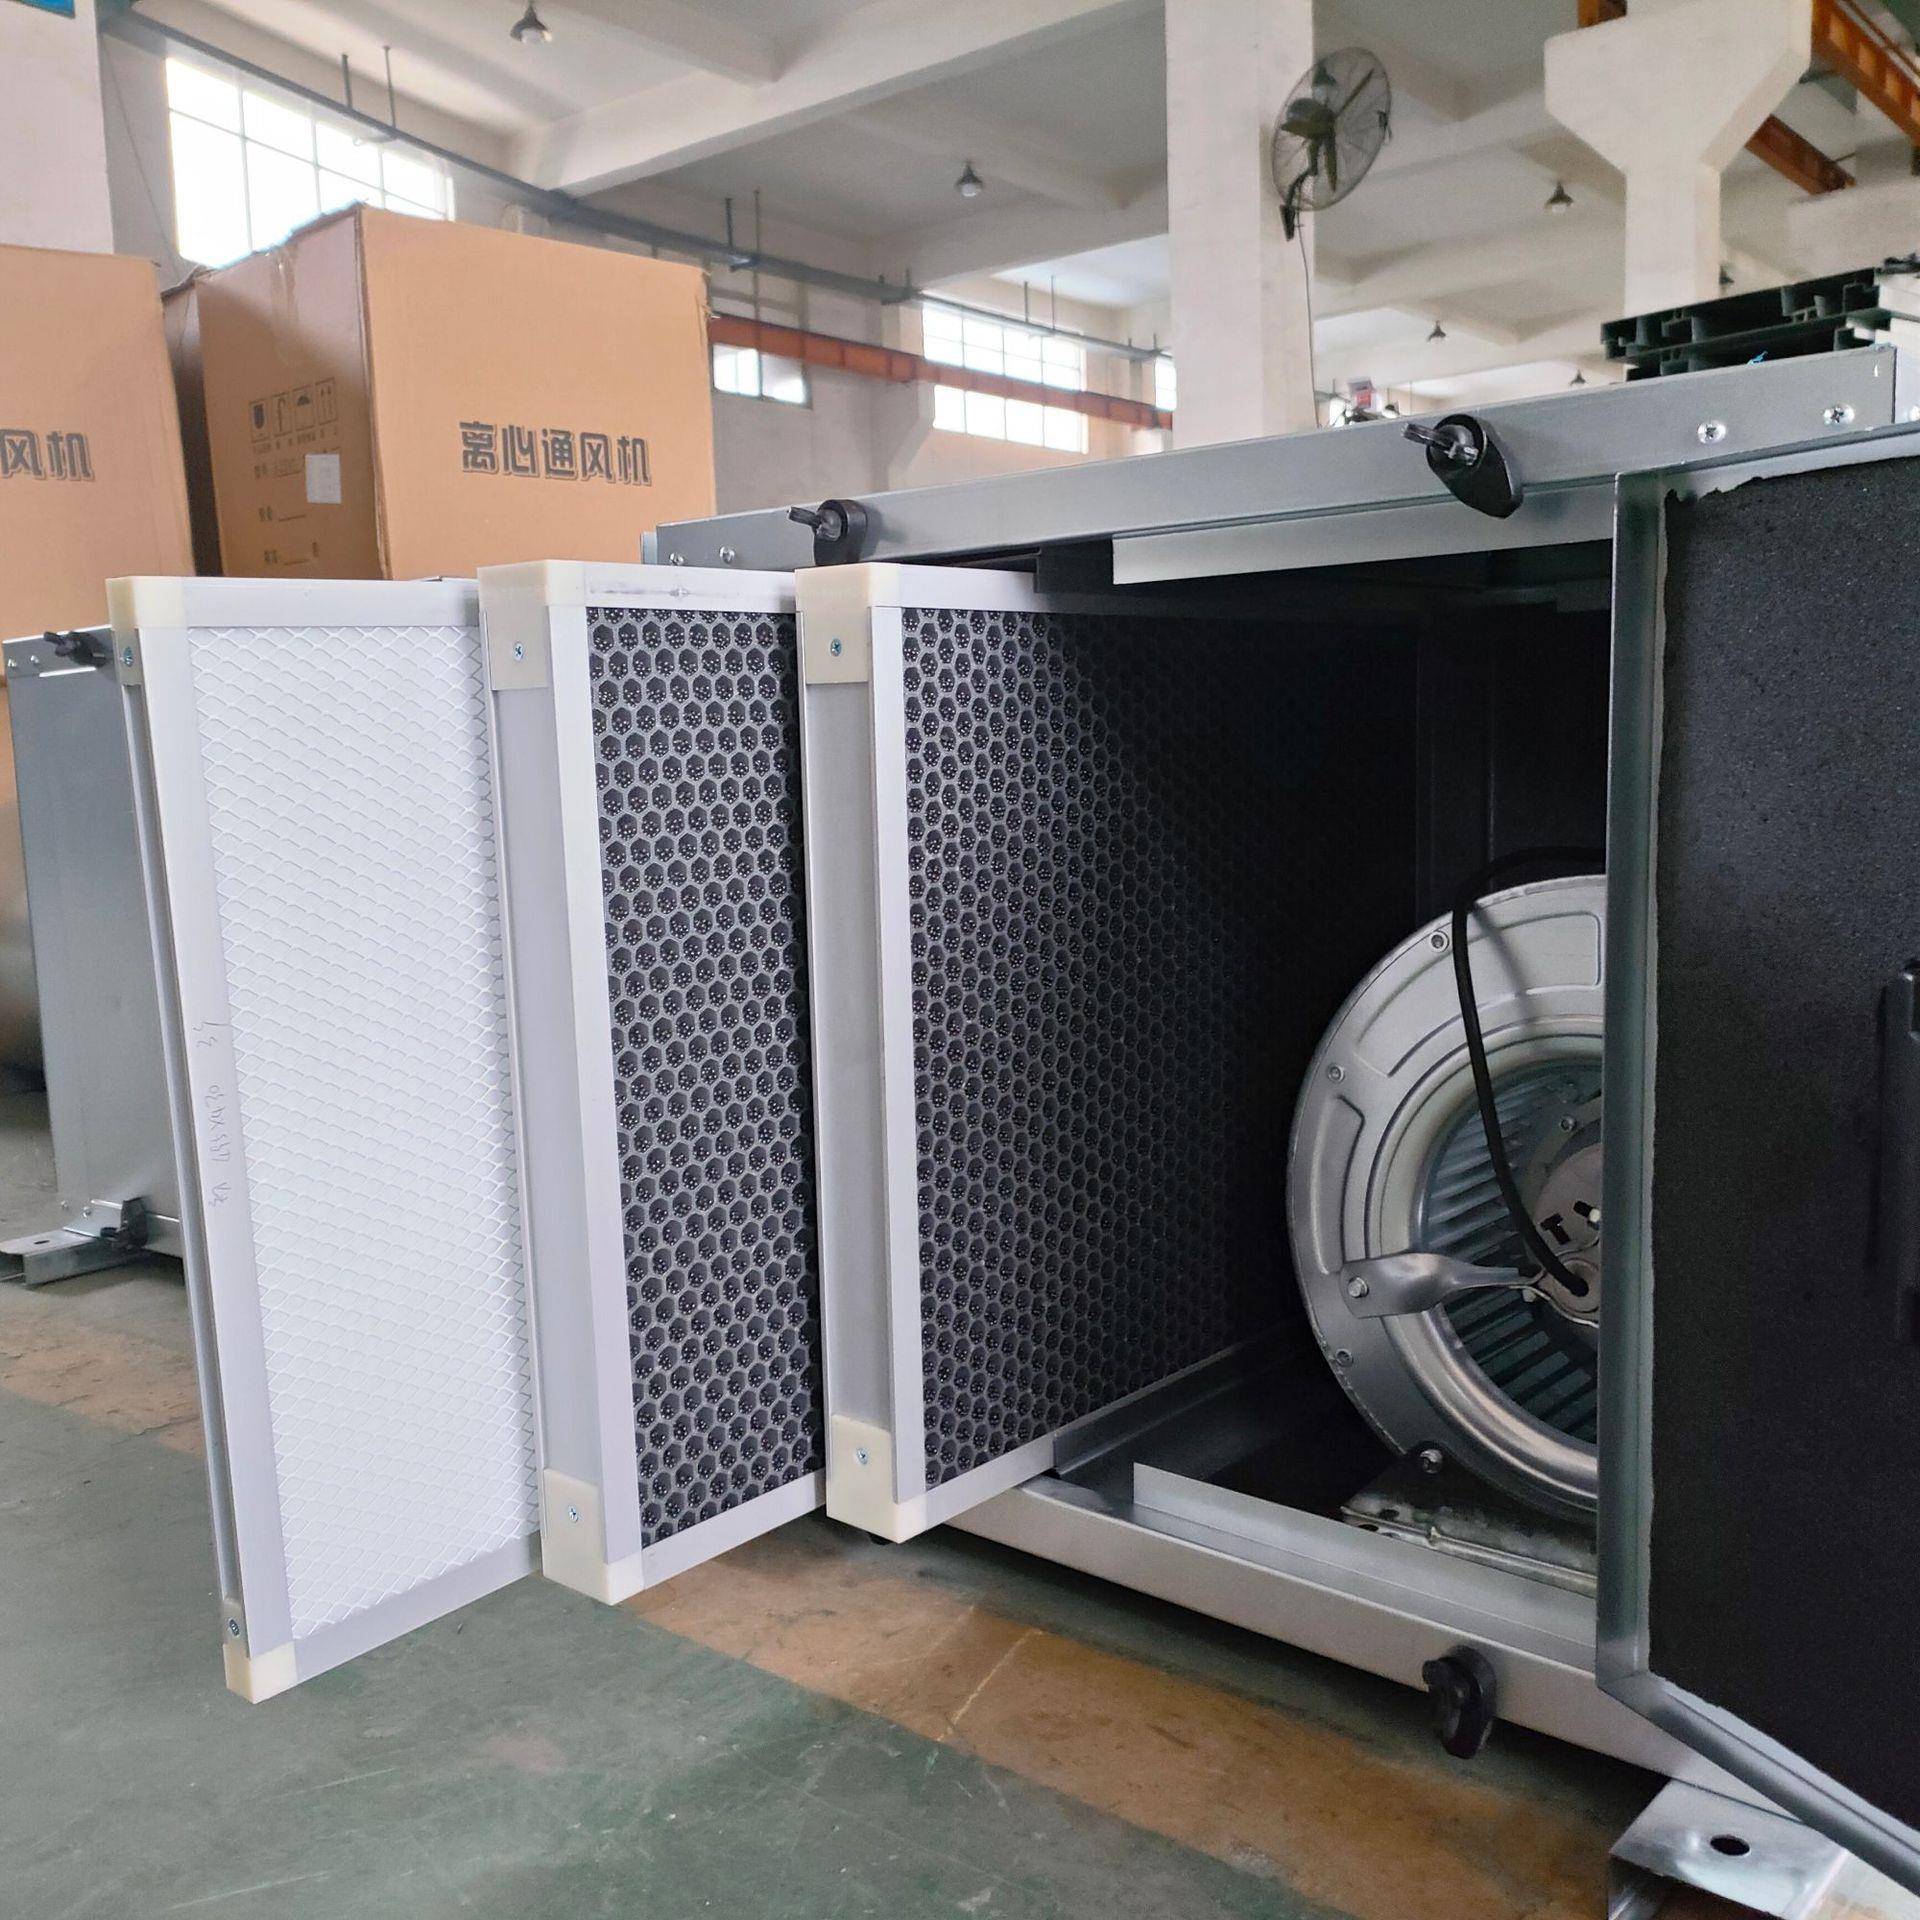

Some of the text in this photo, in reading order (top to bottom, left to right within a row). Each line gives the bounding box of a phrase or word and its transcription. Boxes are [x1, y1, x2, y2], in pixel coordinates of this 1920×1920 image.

[0, 429, 94, 482] 风机
[459, 421, 651, 486] 离心通风机
